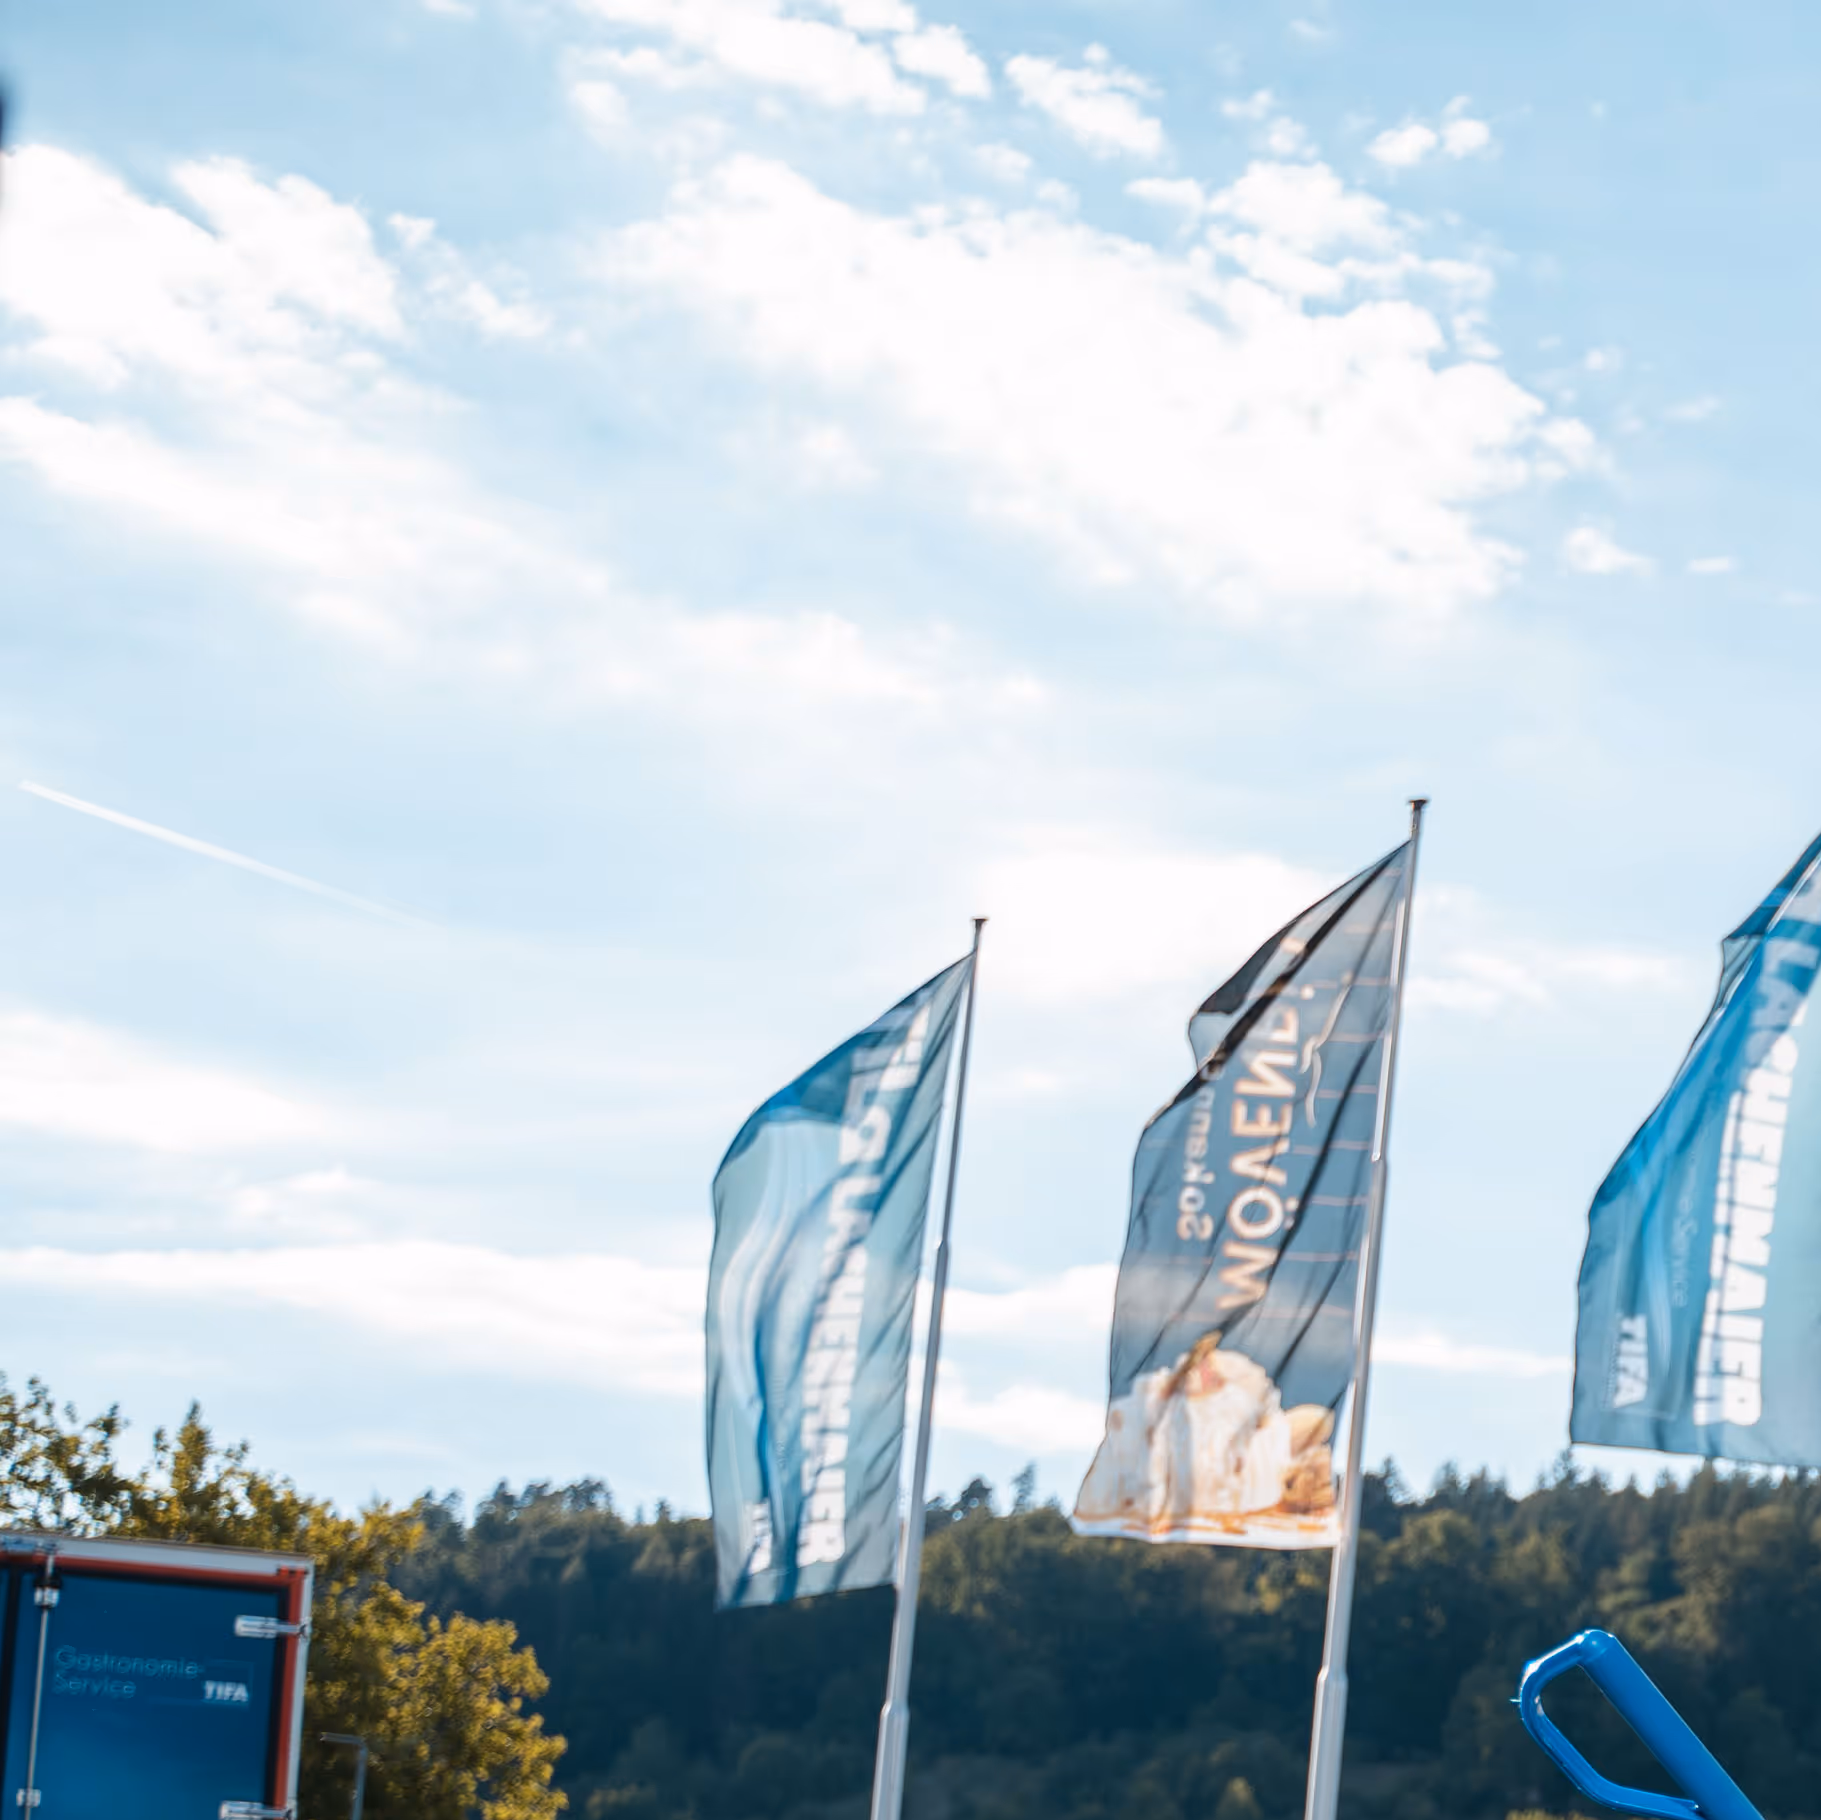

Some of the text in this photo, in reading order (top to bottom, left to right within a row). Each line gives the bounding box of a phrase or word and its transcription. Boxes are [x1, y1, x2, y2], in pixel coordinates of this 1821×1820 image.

[1692, 937, 1821, 1427] LACHENMAIER
[1613, 1313, 1649, 1409] TIFA
[203, 1679, 250, 1703] TIFA
